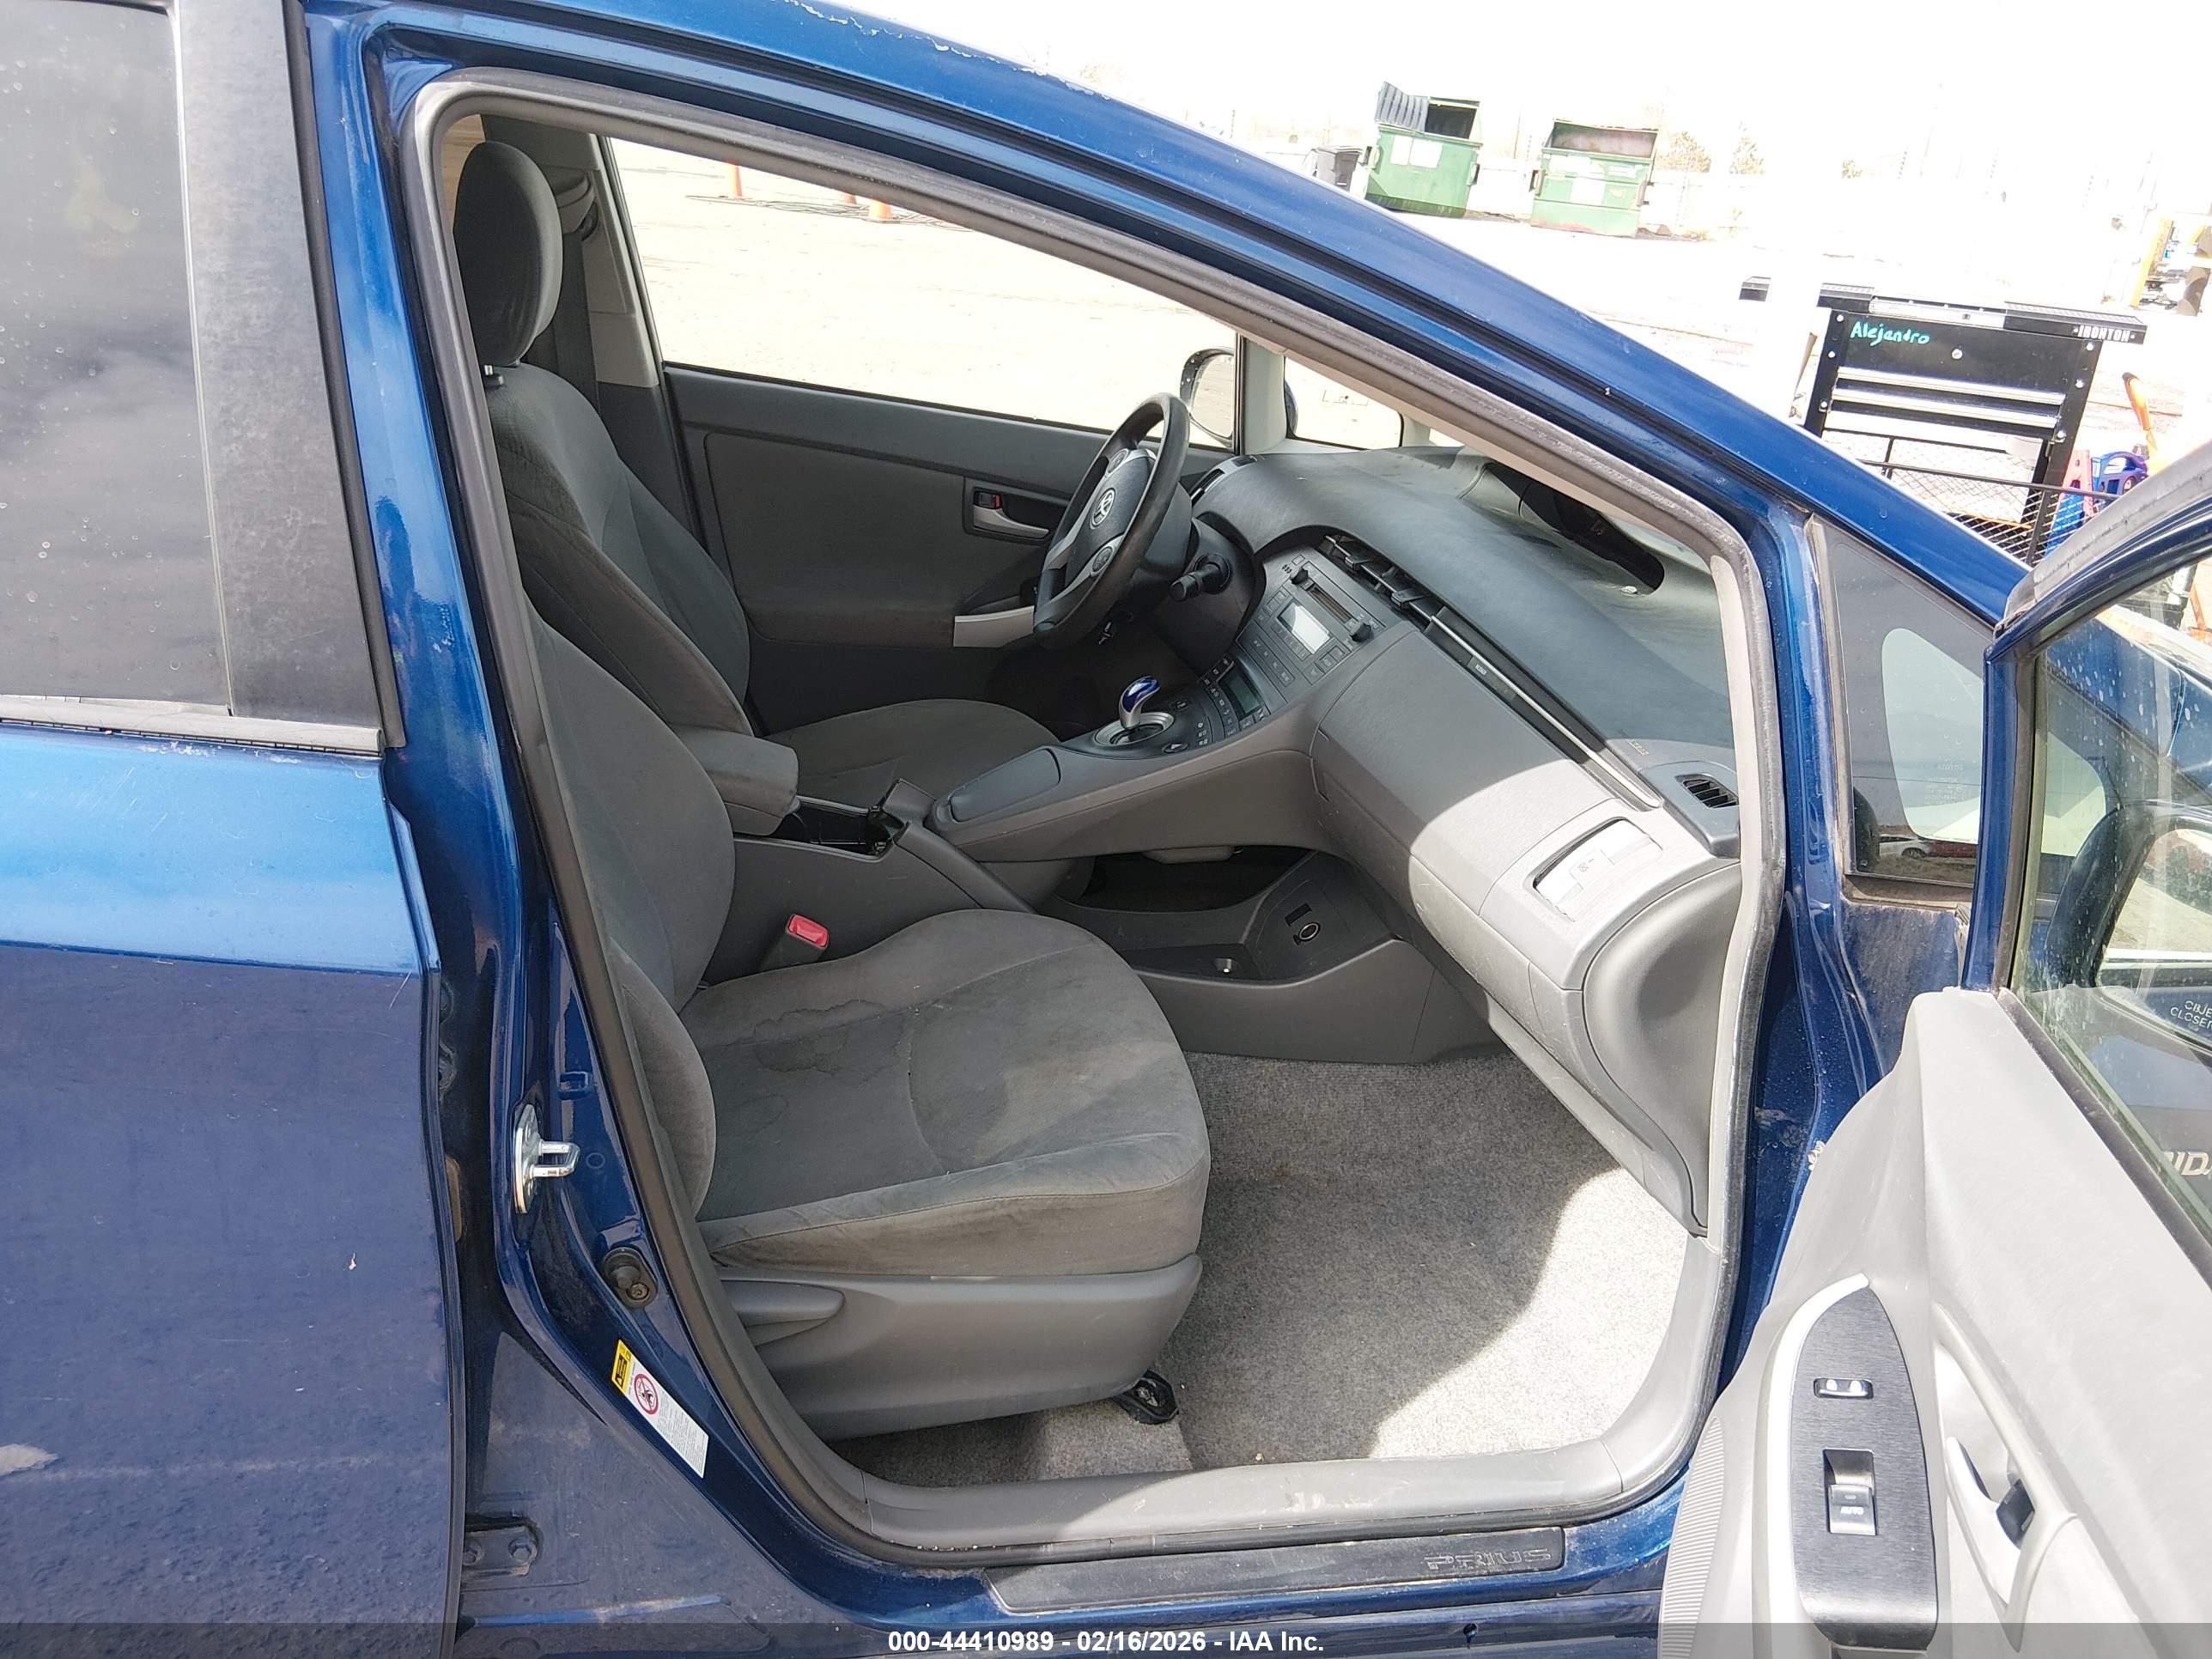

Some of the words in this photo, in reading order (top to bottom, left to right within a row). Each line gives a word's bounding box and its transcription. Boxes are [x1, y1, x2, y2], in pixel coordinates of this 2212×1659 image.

[1850, 320, 1931, 347] Alejandro
[2077, 325, 2131, 343] IRONTON
[1423, 1547, 1553, 1571] PRIUS
